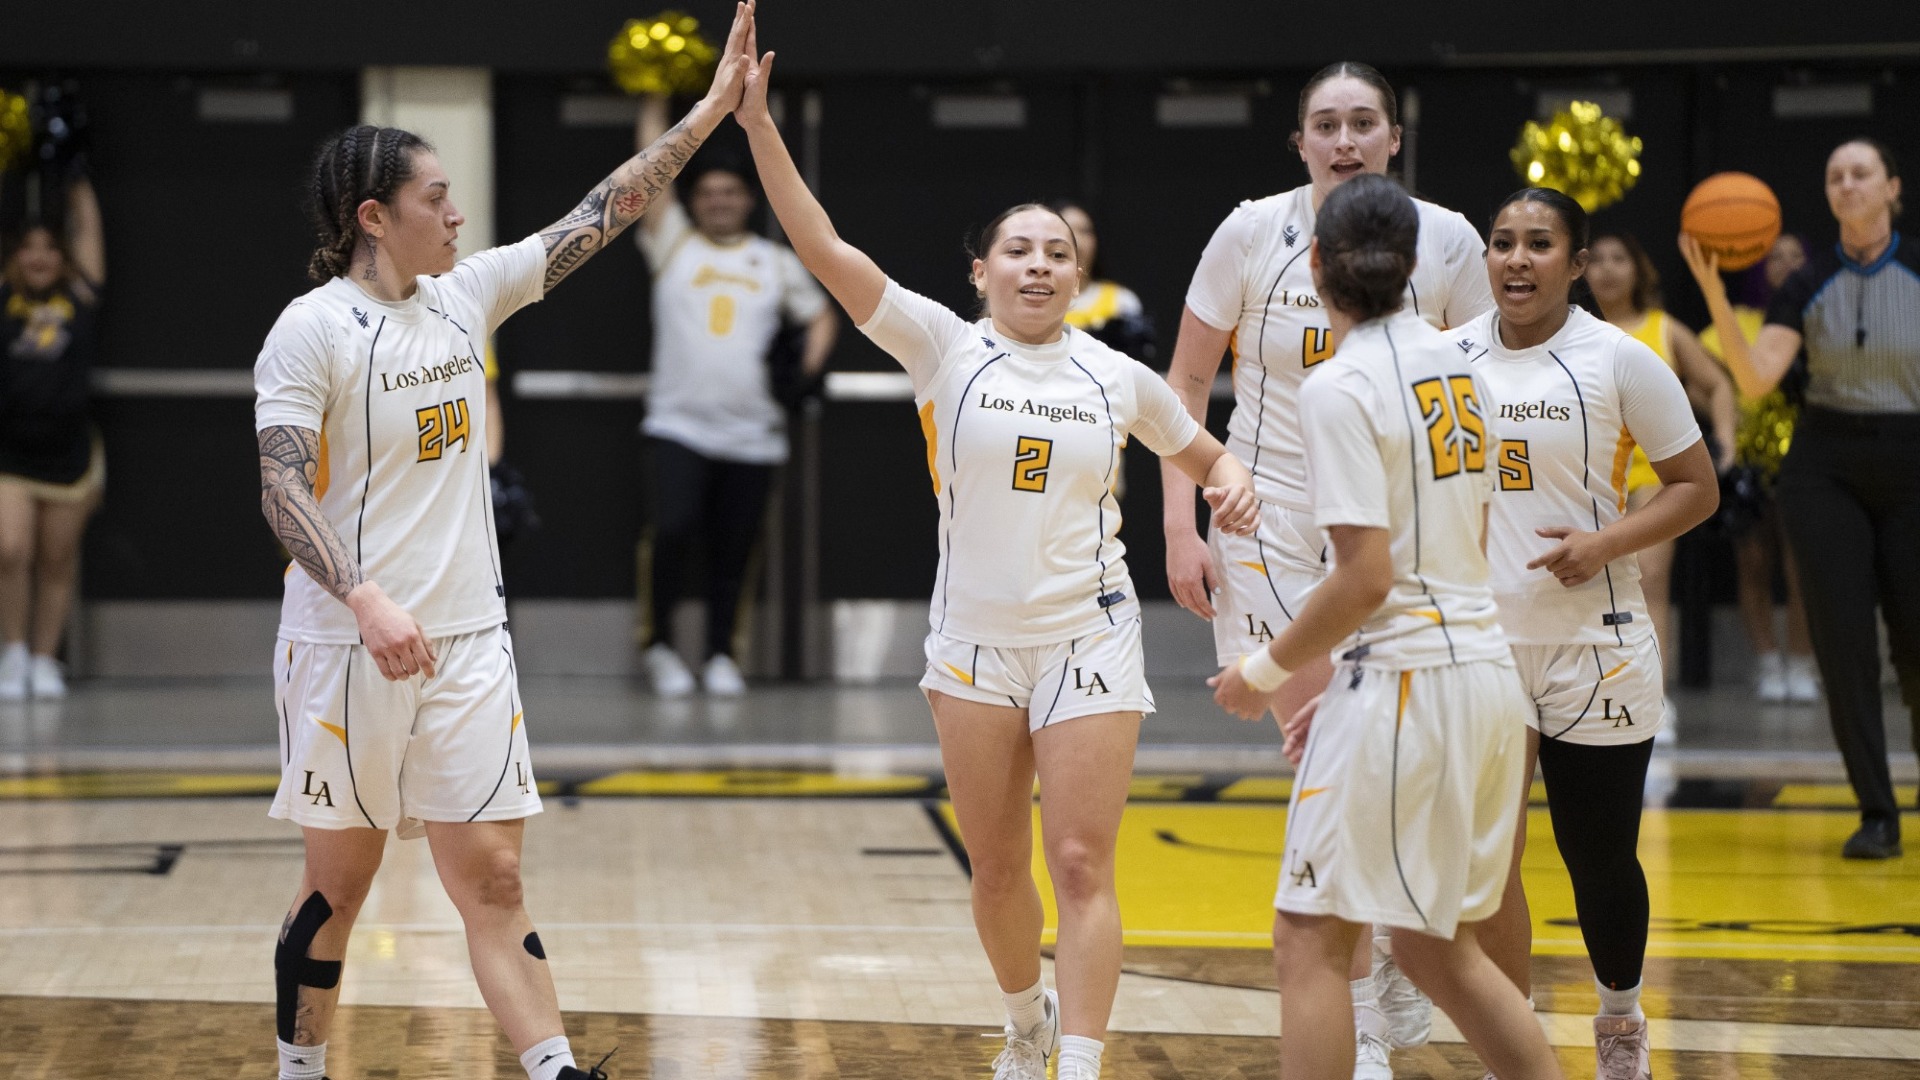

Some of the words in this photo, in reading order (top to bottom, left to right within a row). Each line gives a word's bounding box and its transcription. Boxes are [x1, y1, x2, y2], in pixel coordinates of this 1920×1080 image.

[1282, 289, 1319, 308] Los
[380, 371, 419, 392] Los
[979, 393, 1015, 412] Los
[1018, 399, 1097, 424] Angeles
[1498, 400, 1571, 423] ngeles
[415, 397, 471, 464] 24
[1411, 374, 1486, 481] 25
[1012, 435, 1054, 494] 2
[1244, 613, 1275, 643] LA
[1072, 666, 1112, 697] LA
[1601, 698, 1635, 728] LA
[301, 769, 336, 808] LA
[1289, 849, 1318, 888] LA
